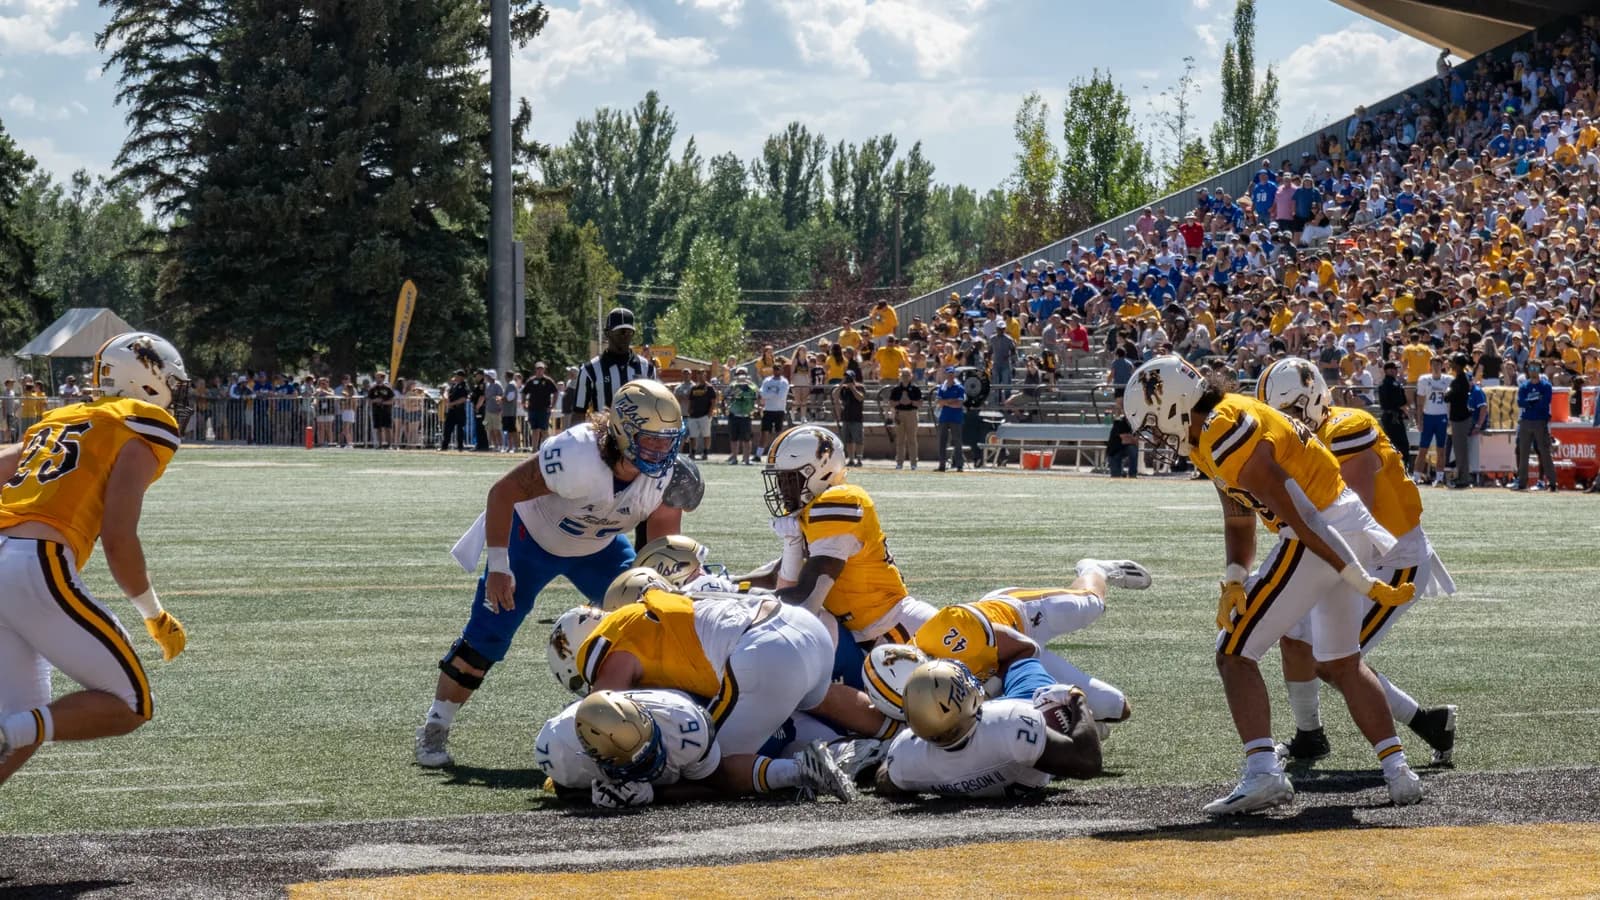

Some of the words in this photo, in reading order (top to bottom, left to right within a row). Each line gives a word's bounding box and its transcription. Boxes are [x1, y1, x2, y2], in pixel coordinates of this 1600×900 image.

[615, 392, 650, 425] Tulsa
[544, 448, 564, 475] 56
[1551, 443, 1596, 459] TORADE
[943, 628, 967, 653] 42
[679, 720, 702, 749] 76
[1017, 715, 1038, 745] 24
